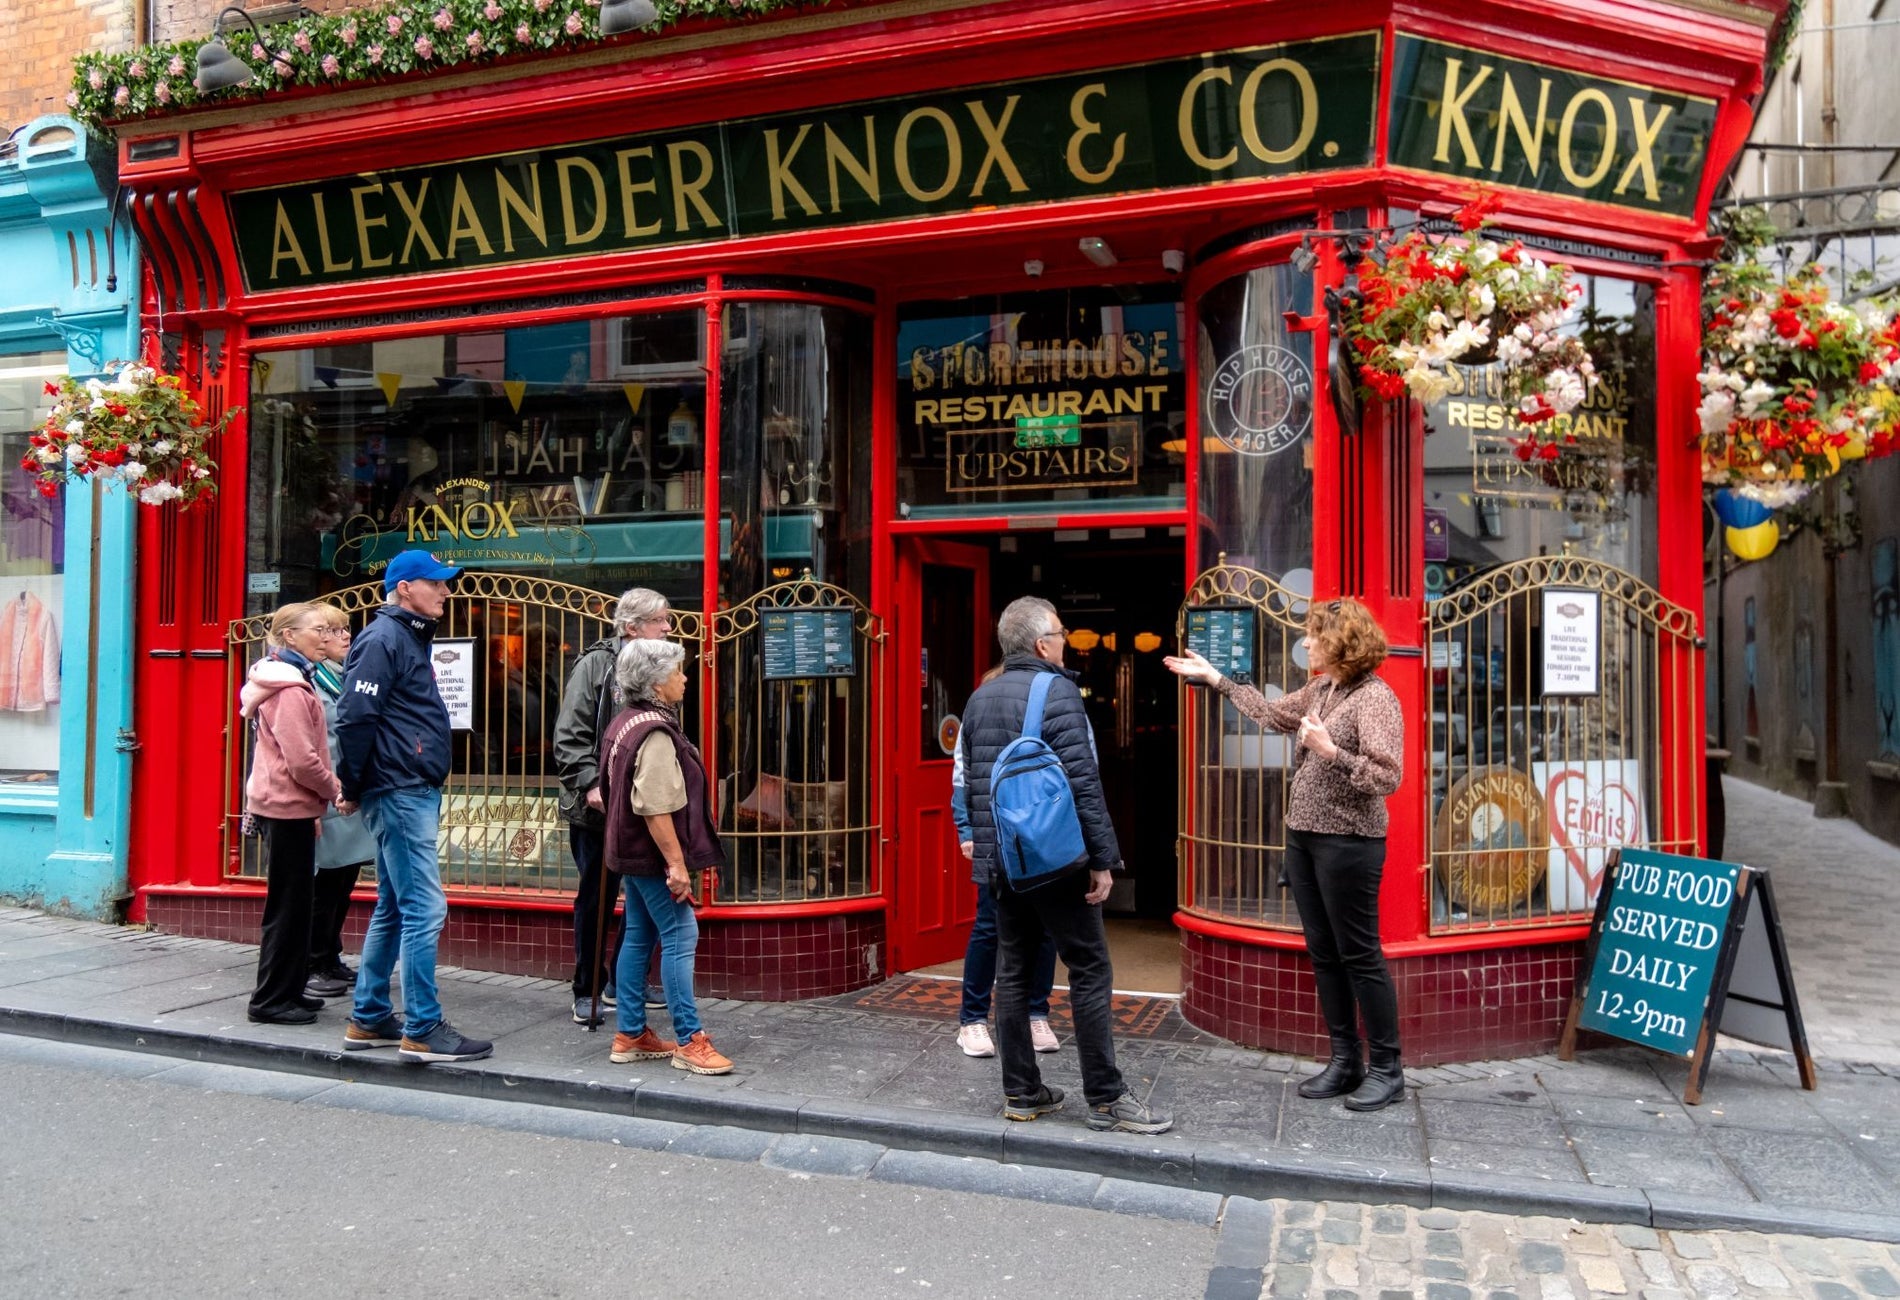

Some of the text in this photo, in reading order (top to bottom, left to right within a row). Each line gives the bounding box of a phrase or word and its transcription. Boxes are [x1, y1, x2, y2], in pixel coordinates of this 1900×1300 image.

[1433, 57, 1674, 202] KNOX
[269, 57, 1340, 280] ALEXANDER KNOX & CO.
[911, 331, 1169, 392] STOREHOUSE
[1213, 349, 1309, 400] HOP HOUSE
[915, 385, 1168, 425] RESTAURANT
[1226, 424, 1294, 450] LAGER
[956, 446, 1130, 480] UPSTAIRS
[435, 477, 490, 496] ALEXANDER
[407, 500, 520, 543] KNOX
[444, 549, 472, 559] PEOPLE
[474, 549, 484, 558] OF
[486, 549, 508, 560] ENNIS
[509, 551, 532, 561] SINCE
[411, 620, 425, 630] HH
[355, 680, 379, 696] HH
[436, 677, 465, 685] ADITIONAL
[1617, 862, 1732, 908] PUB FOOD
[1610, 906, 1718, 950] SERVED
[1609, 948, 1697, 991] DAILY
[1596, 990, 1686, 1037] 12-9pm
